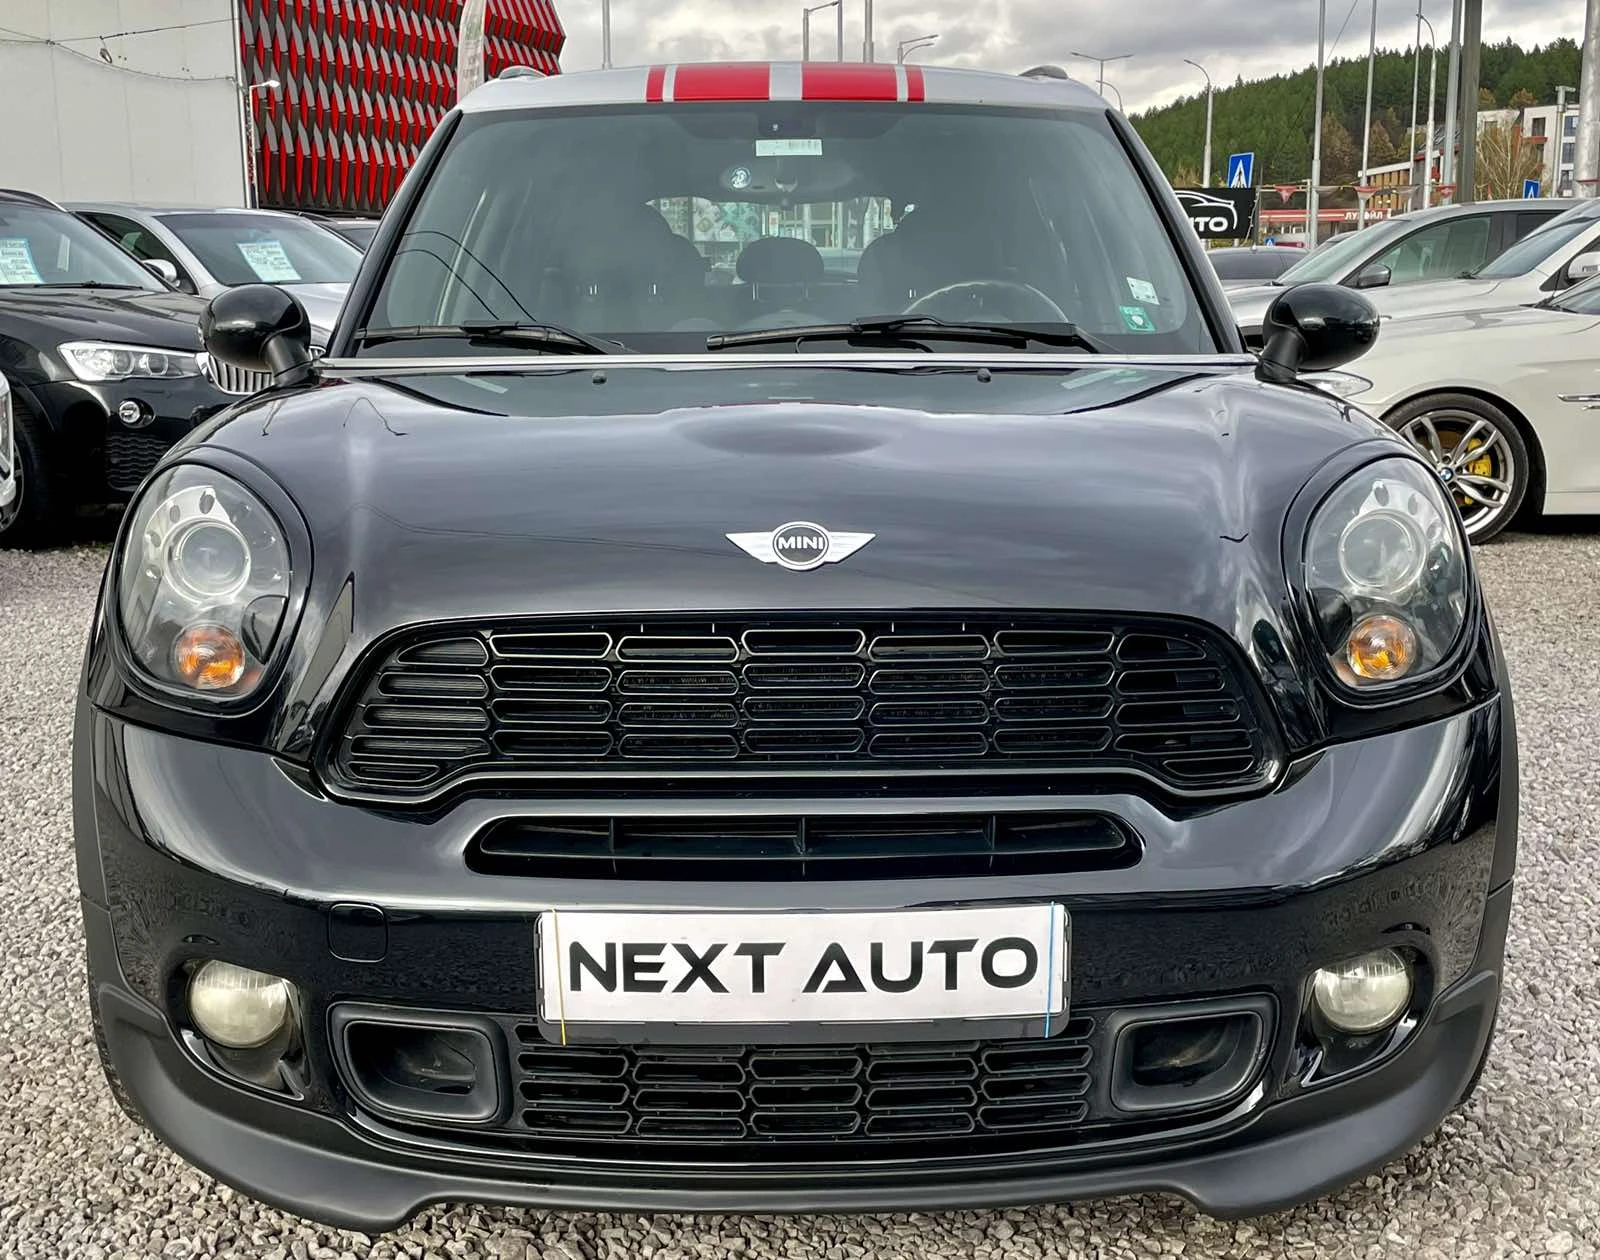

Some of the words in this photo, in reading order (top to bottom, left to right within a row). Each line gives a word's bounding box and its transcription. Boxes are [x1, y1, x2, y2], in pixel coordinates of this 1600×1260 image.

[1344, 209, 1383, 220] ЛУОЙЛ
[778, 535, 824, 550] MINI
[568, 942, 786, 993] NEXT
[802, 936, 1038, 993] AUTO
